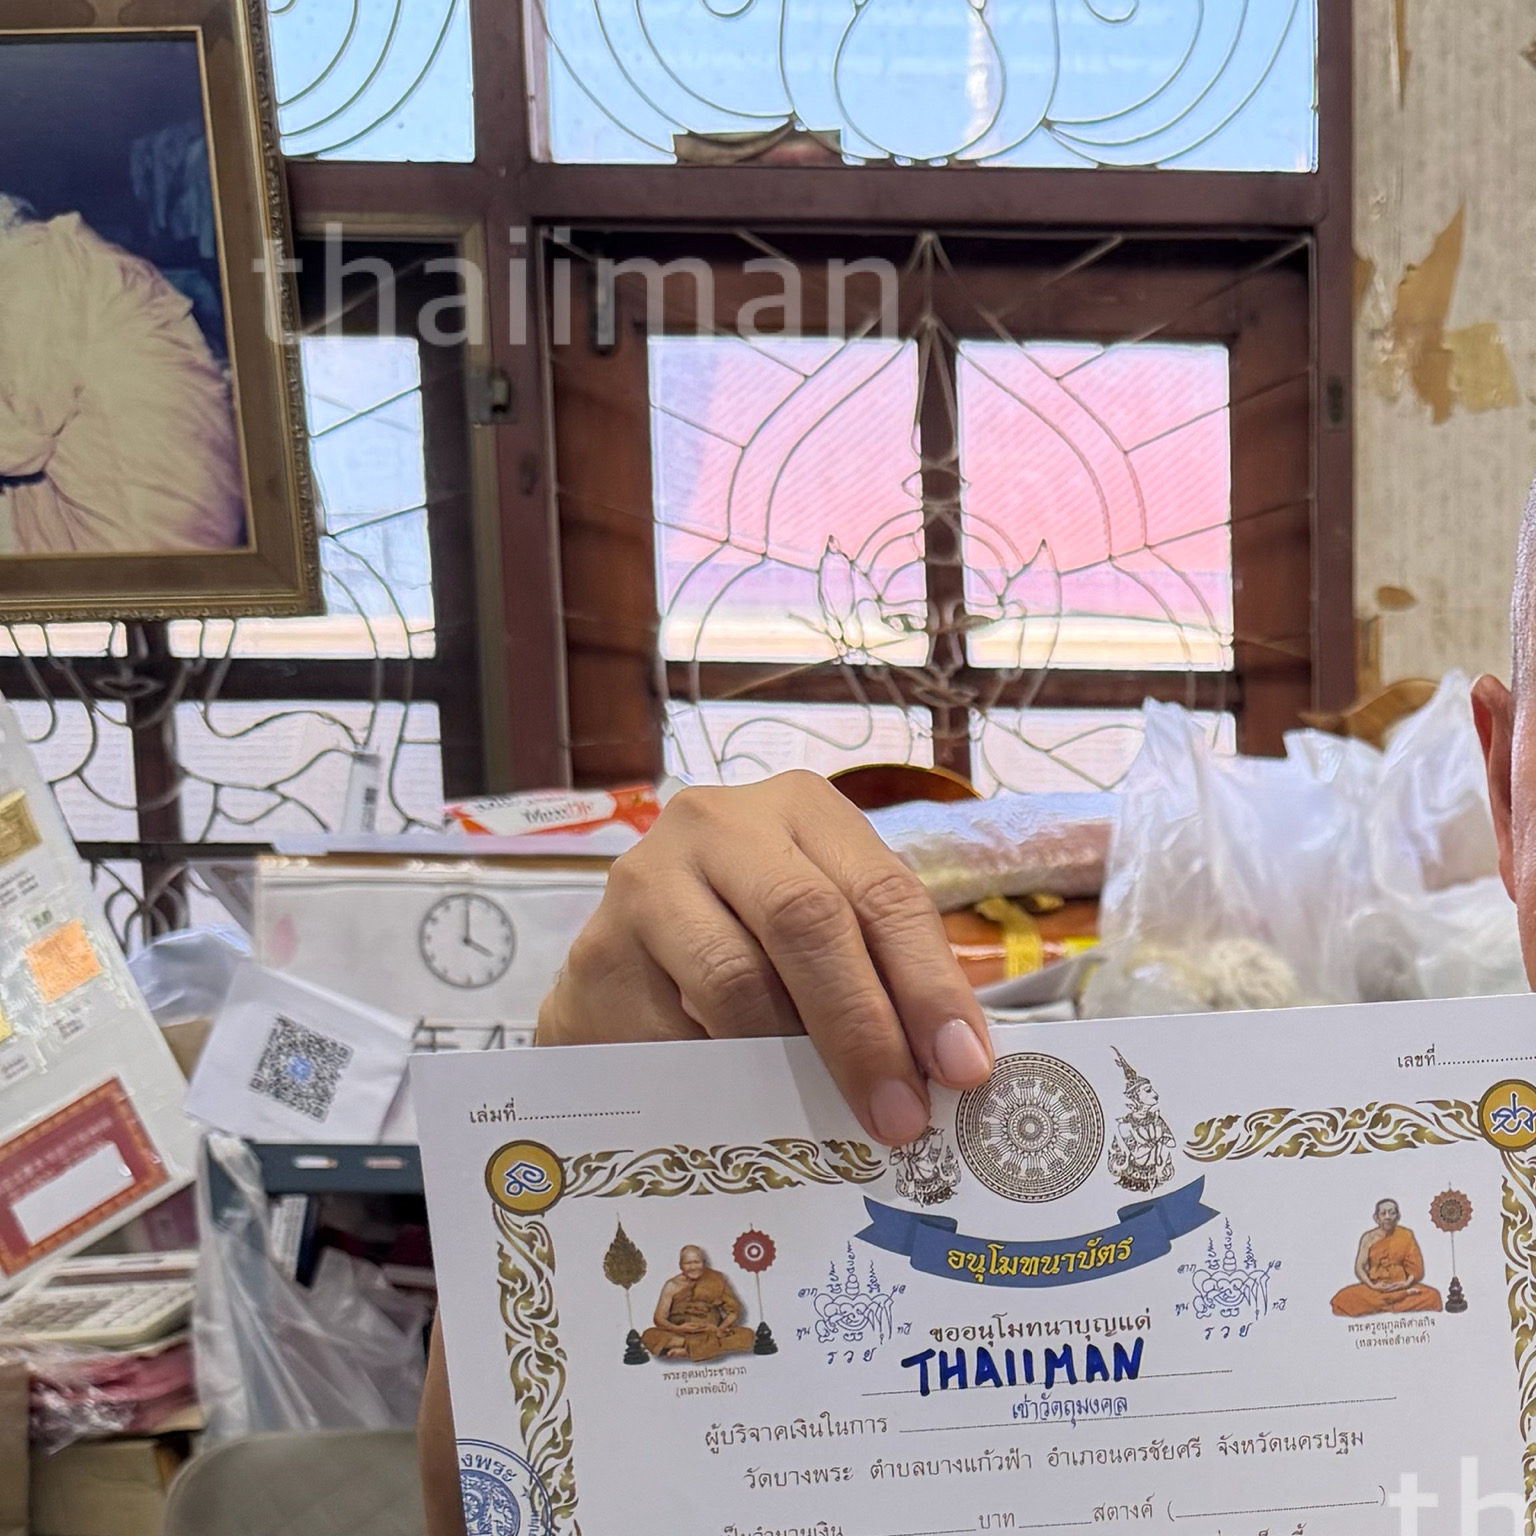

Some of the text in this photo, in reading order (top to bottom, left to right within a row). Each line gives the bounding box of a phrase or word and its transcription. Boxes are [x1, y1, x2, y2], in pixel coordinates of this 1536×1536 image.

[1398, 1044, 1437, 1068] เลขที่
[469, 1098, 517, 1124] เล่มที่
[946, 1235, 1134, 1283] อนุโมทนาบัตร
[929, 1307, 1152, 1344] ขออนุโมทนาบุญแด่
[901, 1337, 1146, 1397] THAIIMAN
[704, 1411, 889, 1454] ผู้บริจาคเงินในการ
[743, 1427, 1365, 1491] วัดบางพระ ตำบลบางแก้วฟ้า อำเภอนครชัยศรี จังหวัดนครปฐม
[978, 1511, 1016, 1530] บาท
[1092, 1493, 1156, 1523] สตางค์
